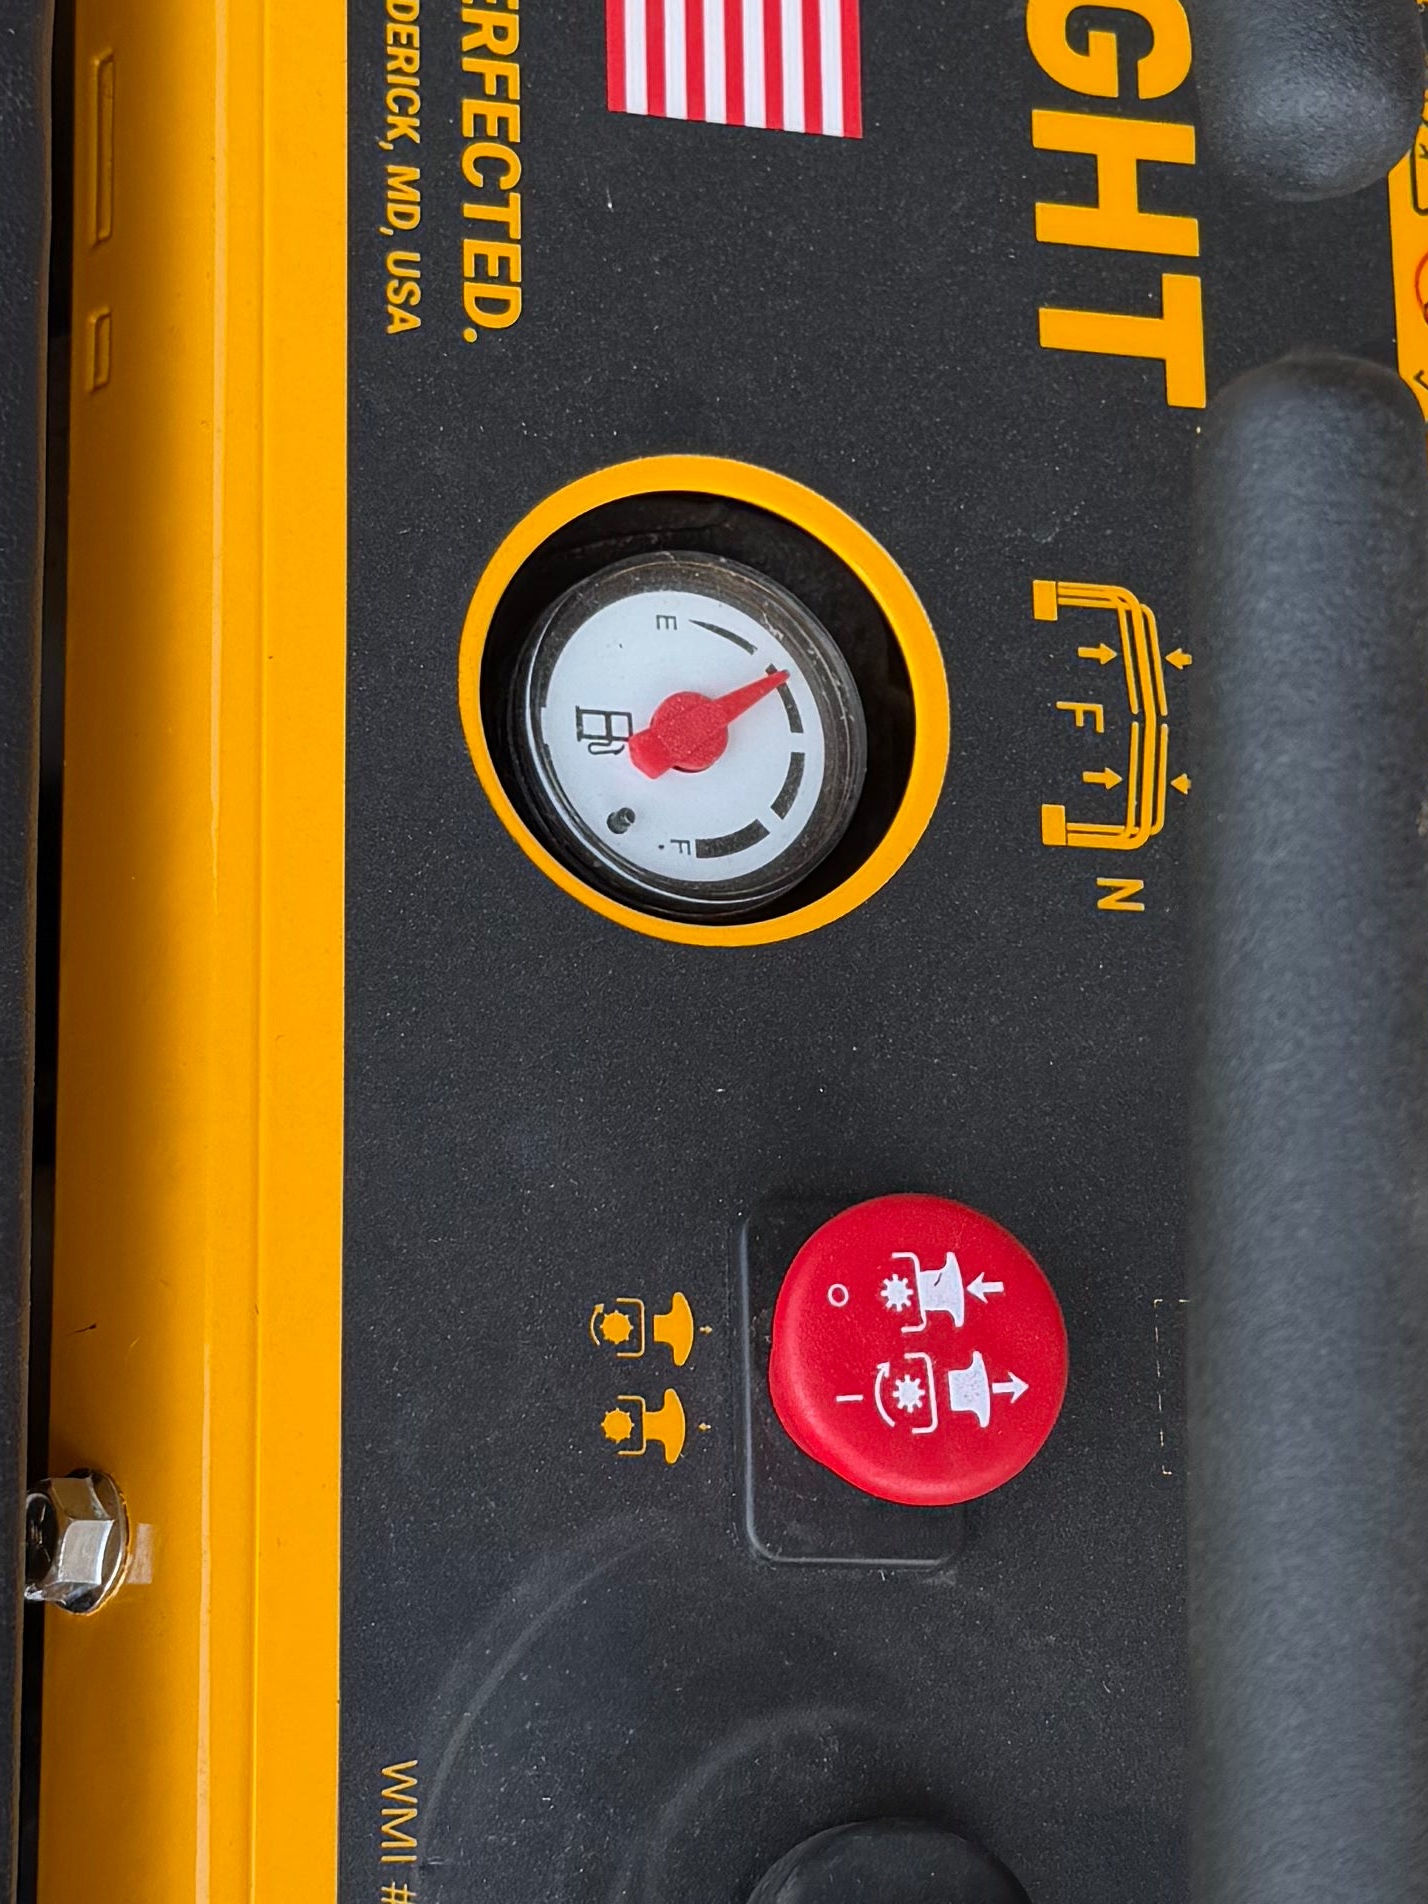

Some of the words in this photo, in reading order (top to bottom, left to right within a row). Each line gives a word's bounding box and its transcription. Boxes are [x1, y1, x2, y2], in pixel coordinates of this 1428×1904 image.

[378, 164, 421, 236] MD,
[386, 250, 422, 335] USA
[656, 612, 678, 632] E
[1056, 700, 1105, 734] F
[669, 837, 692, 856] F
[1096, 876, 1145, 912] N
[380, 1759, 419, 1863] WMI
